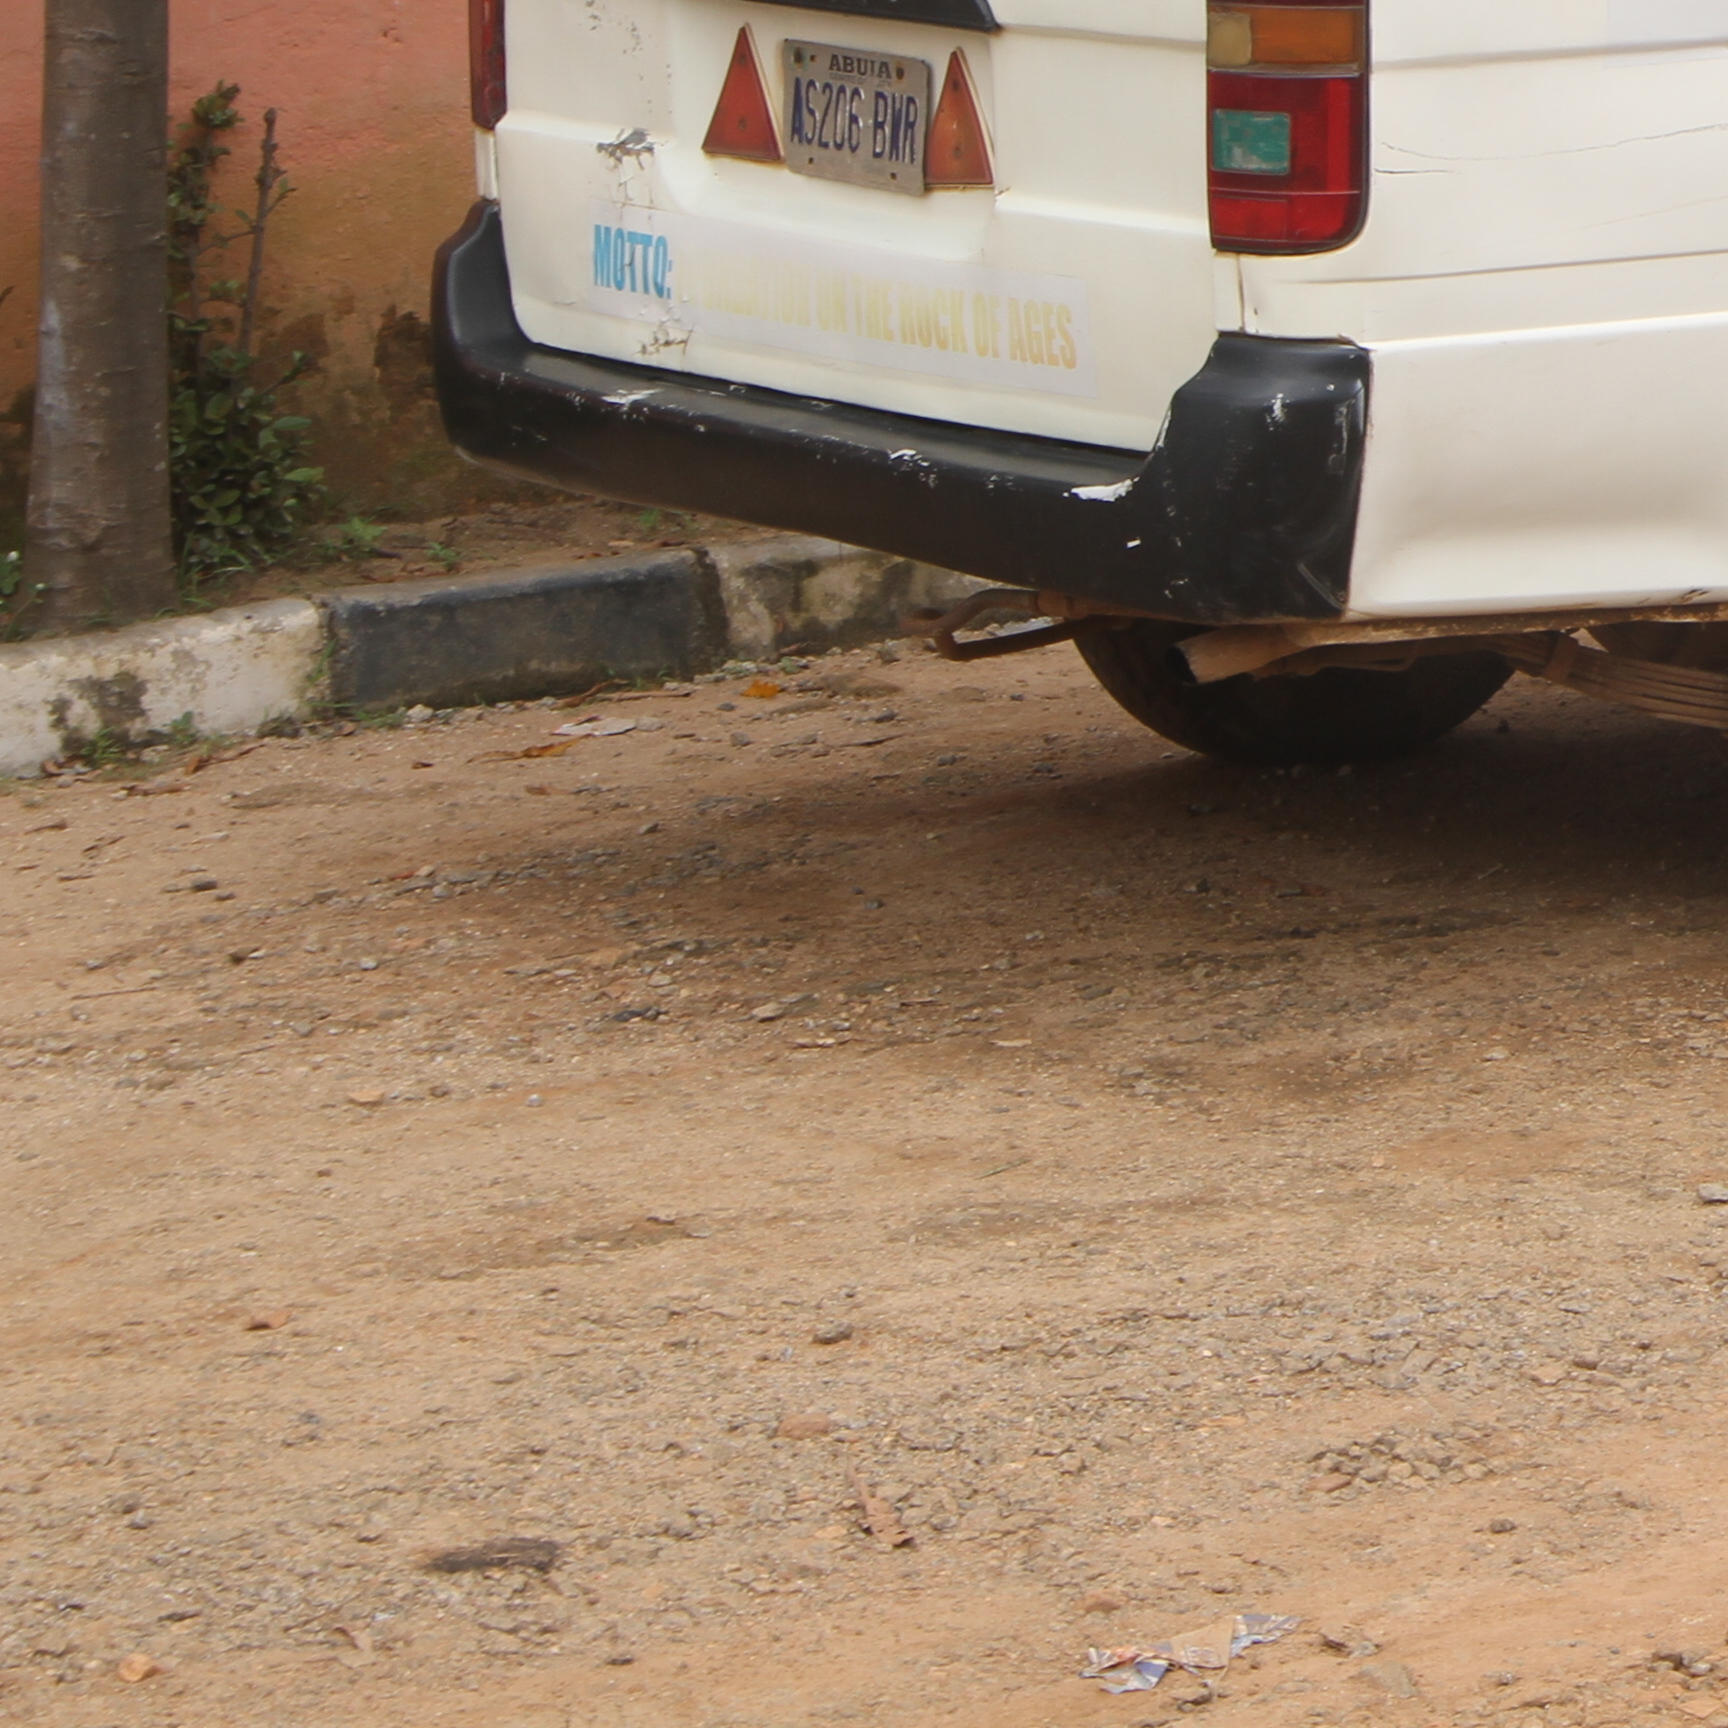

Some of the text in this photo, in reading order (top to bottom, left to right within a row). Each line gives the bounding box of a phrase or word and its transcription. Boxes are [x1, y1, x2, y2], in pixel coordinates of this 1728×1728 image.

[593, 224, 673, 300] MOTTO:
[852, 274, 895, 342] THE
[900, 281, 968, 354] ROCK
[972, 291, 1001, 359] OF
[1009, 298, 1078, 370] AGES
